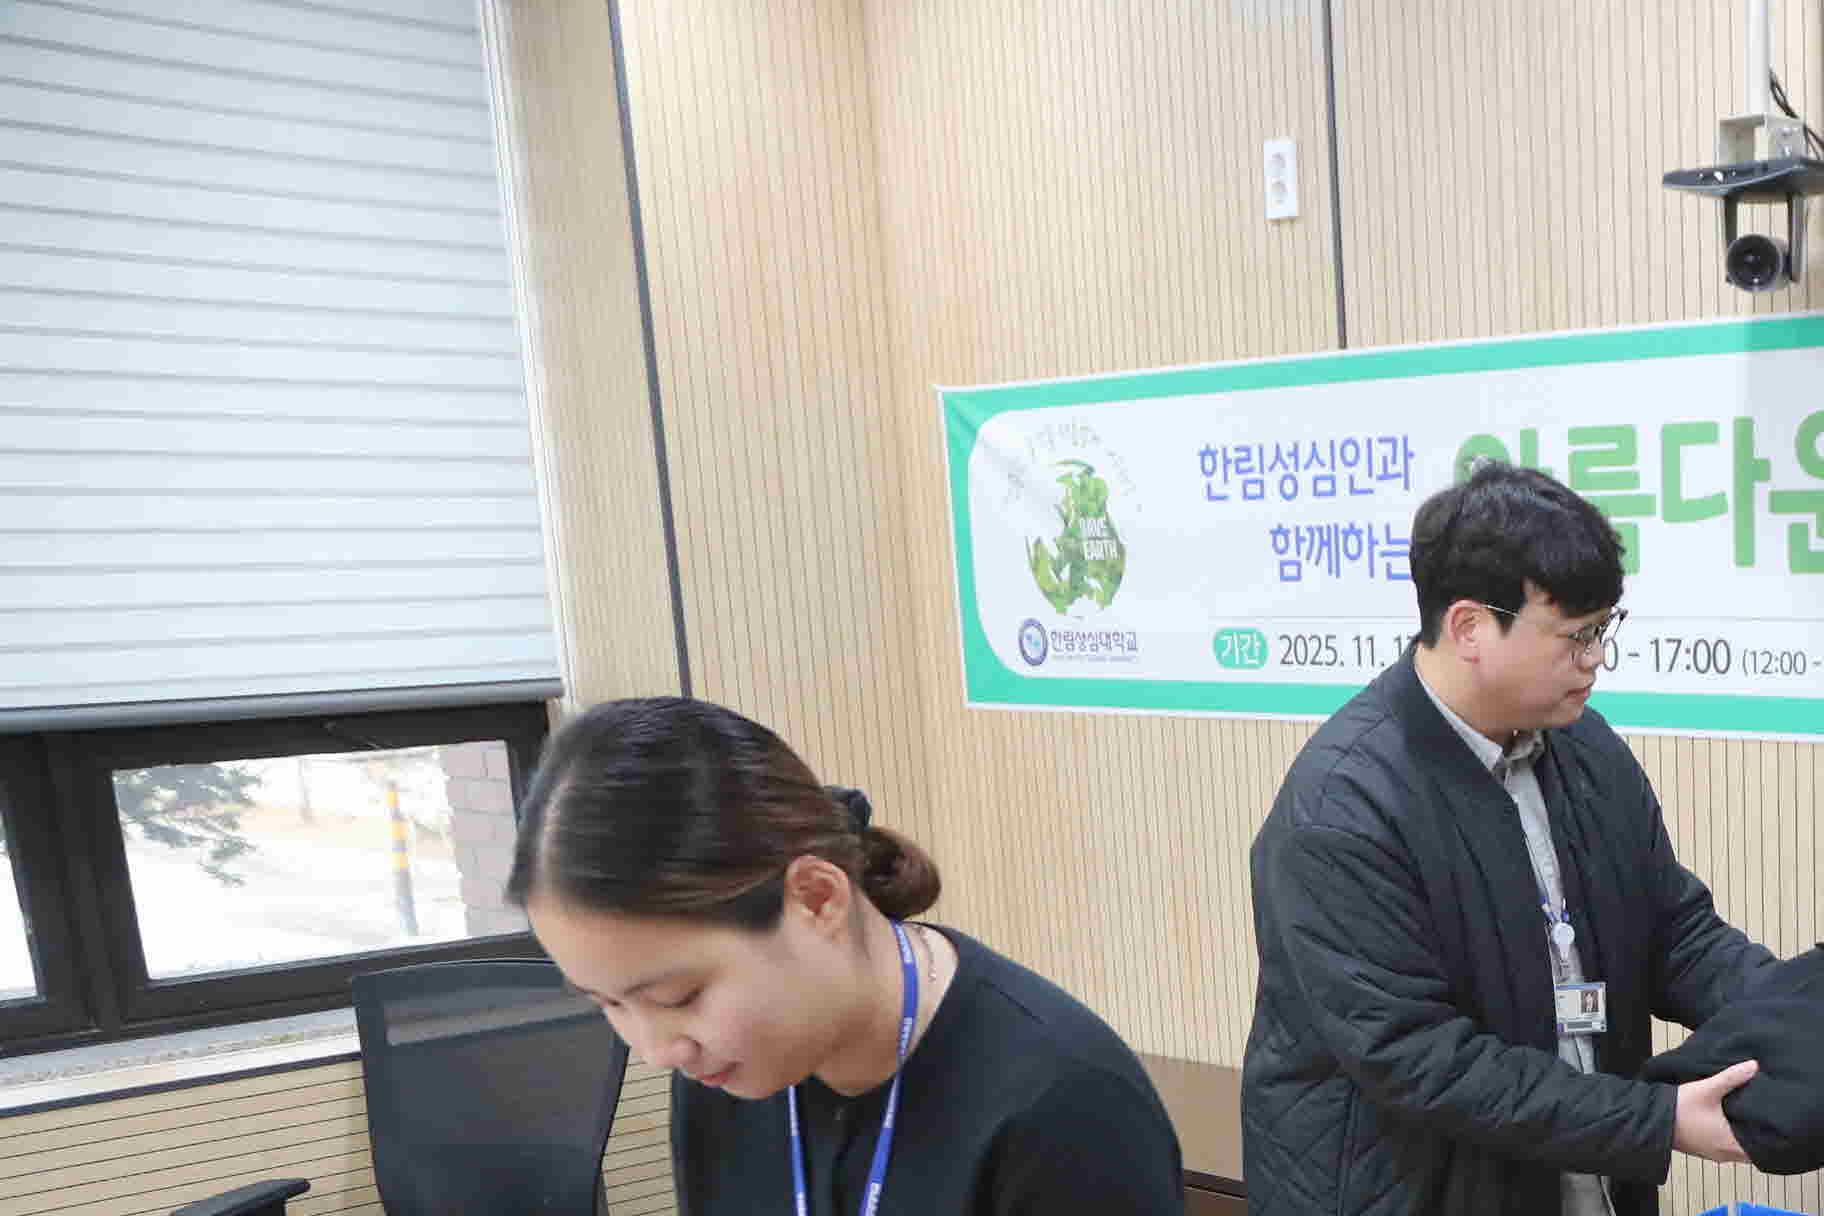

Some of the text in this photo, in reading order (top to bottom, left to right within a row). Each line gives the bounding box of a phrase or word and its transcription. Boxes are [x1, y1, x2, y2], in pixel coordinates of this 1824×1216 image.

[1198, 434, 1415, 502] 한림성심인과
[1269, 520, 1412, 582] 함께하는
[1218, 630, 1262, 666] 기간
[1278, 633, 1345, 667] 2025.
[1351, 633, 1385, 667] 11.
[1649, 636, 1732, 675] 17:00
[1742, 649, 1807, 677] (12:00
